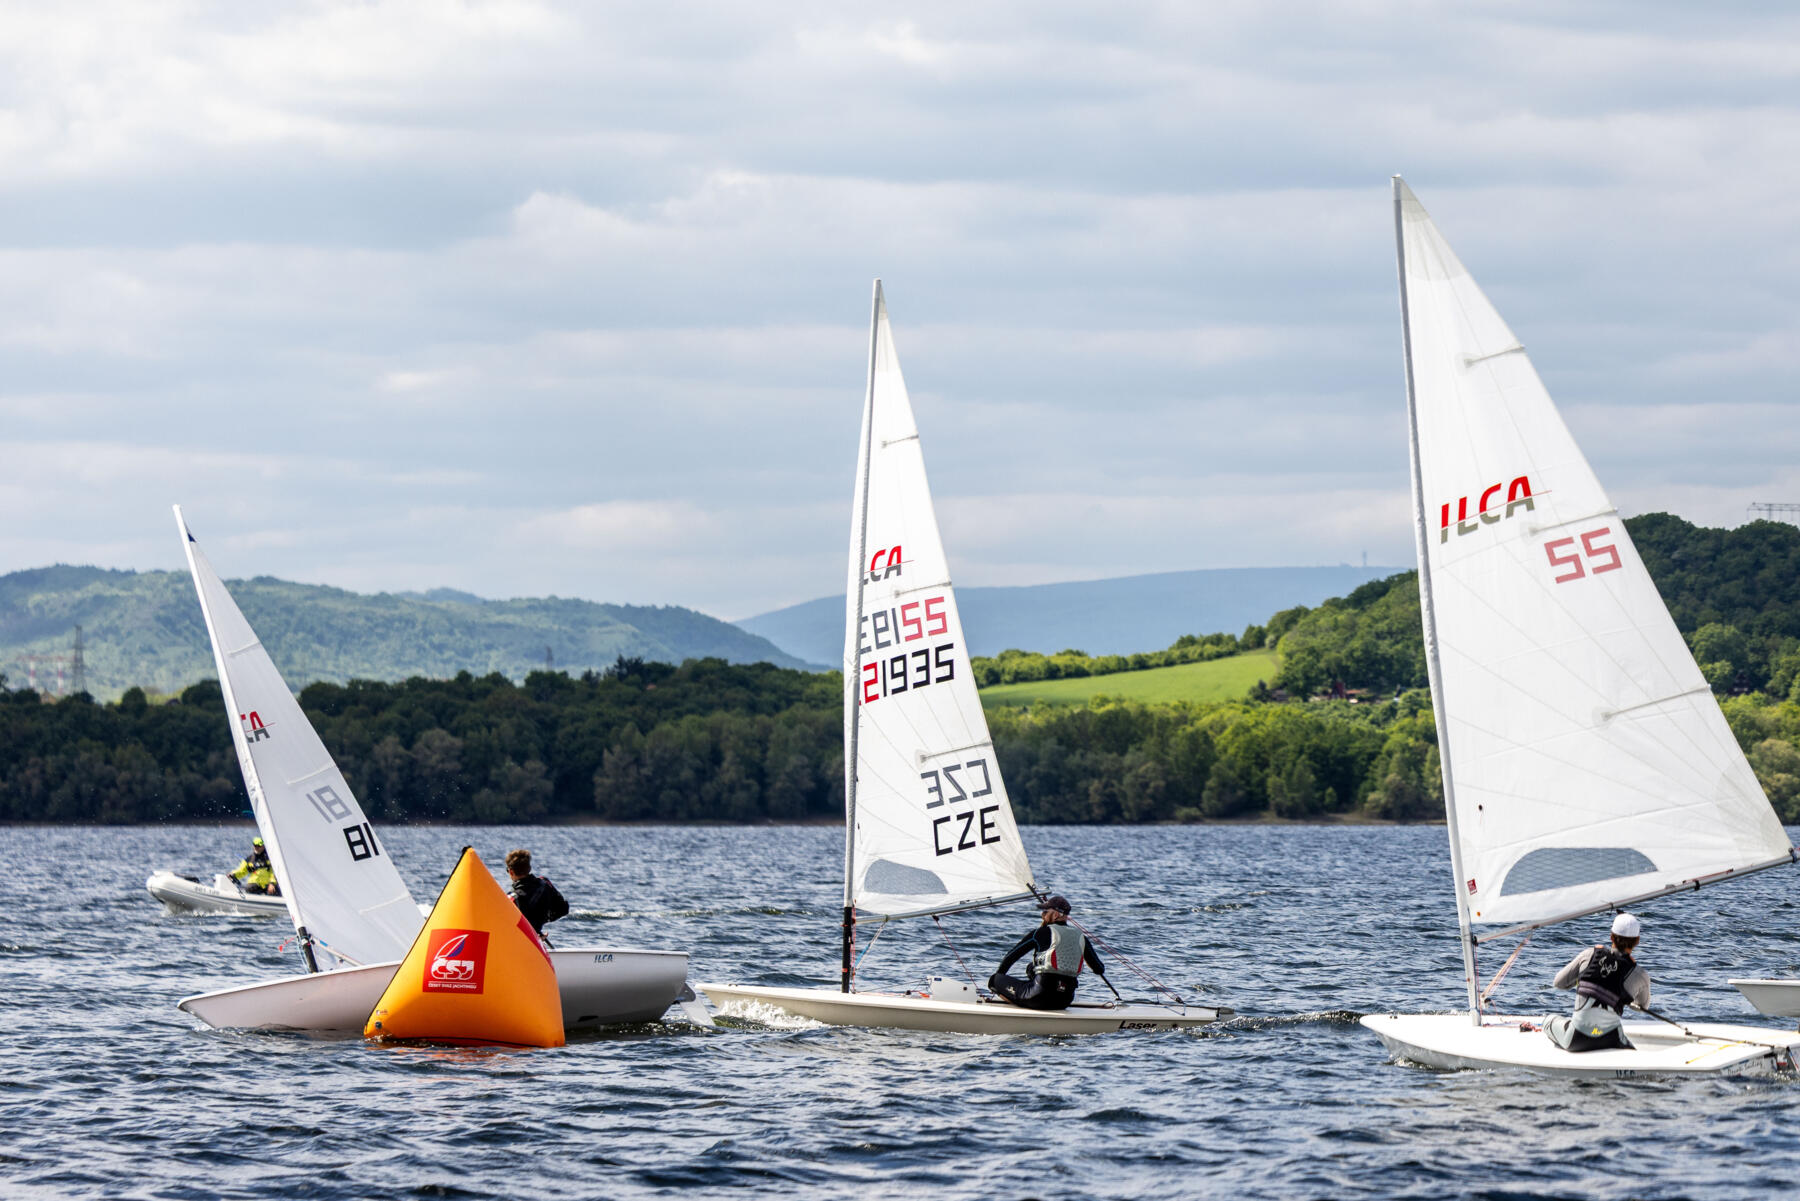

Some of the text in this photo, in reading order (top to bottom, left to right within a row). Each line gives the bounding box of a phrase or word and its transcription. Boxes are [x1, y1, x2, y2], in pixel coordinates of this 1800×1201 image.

[1440, 475, 1536, 545] ILCA
[864, 545, 903, 585] CA
[861, 643, 955, 704] 21935
[342, 822, 380, 862] 81
[932, 804, 1001, 857] CZE
[594, 954, 613, 963] ILCA
[1118, 1020, 1157, 1030] Laser
